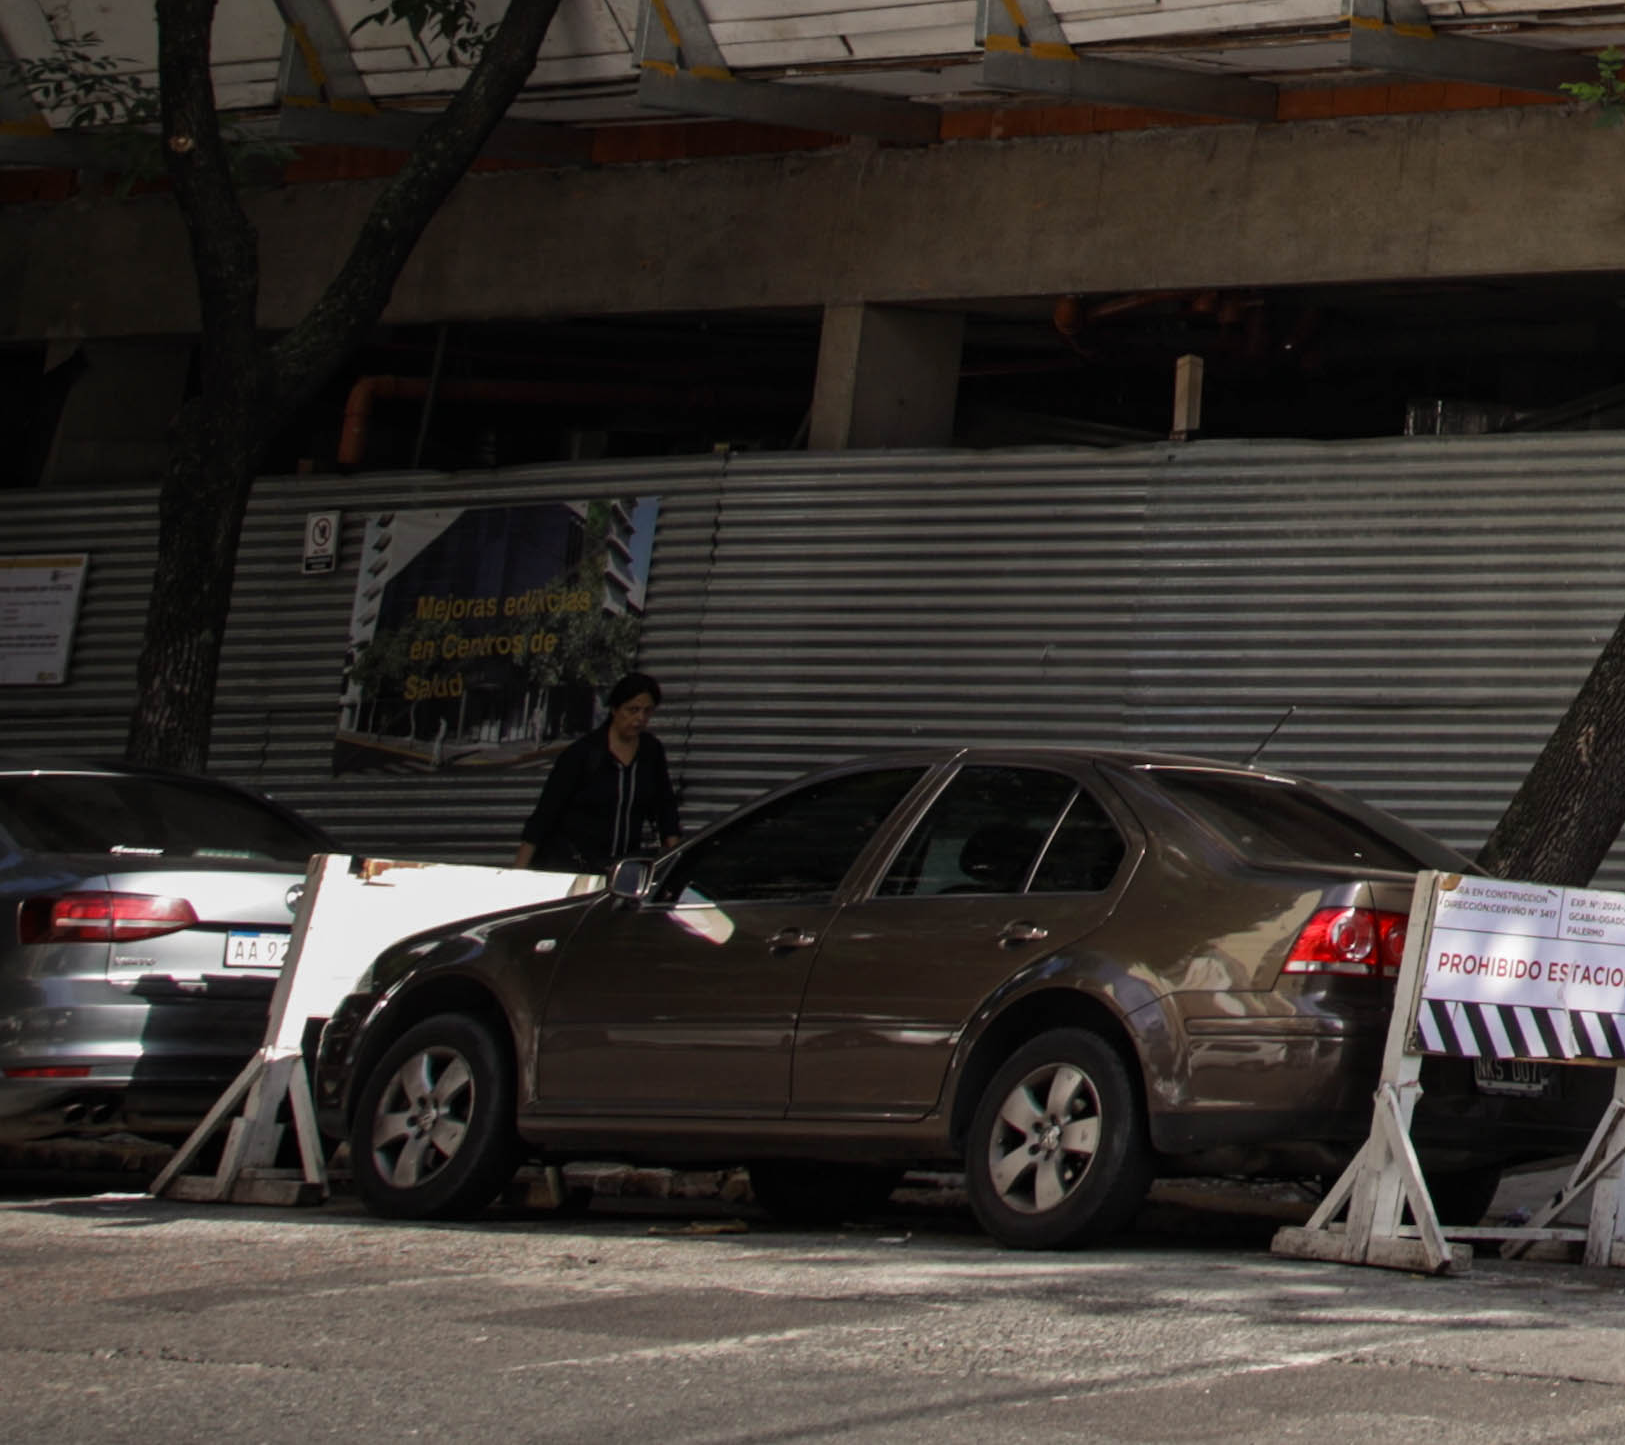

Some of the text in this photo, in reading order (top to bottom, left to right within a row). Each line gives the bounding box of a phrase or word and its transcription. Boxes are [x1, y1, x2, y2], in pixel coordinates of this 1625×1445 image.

[416, 596, 497, 623] Mejoras
[410, 629, 558, 660] en Centros de
[404, 674, 464, 701] Salud
[1540, 910, 1557, 919] 3417
[1567, 927, 1604, 937] PALERMO
[235, 941, 257, 960] AA
[1437, 952, 1542, 981] PROHIBIDO
